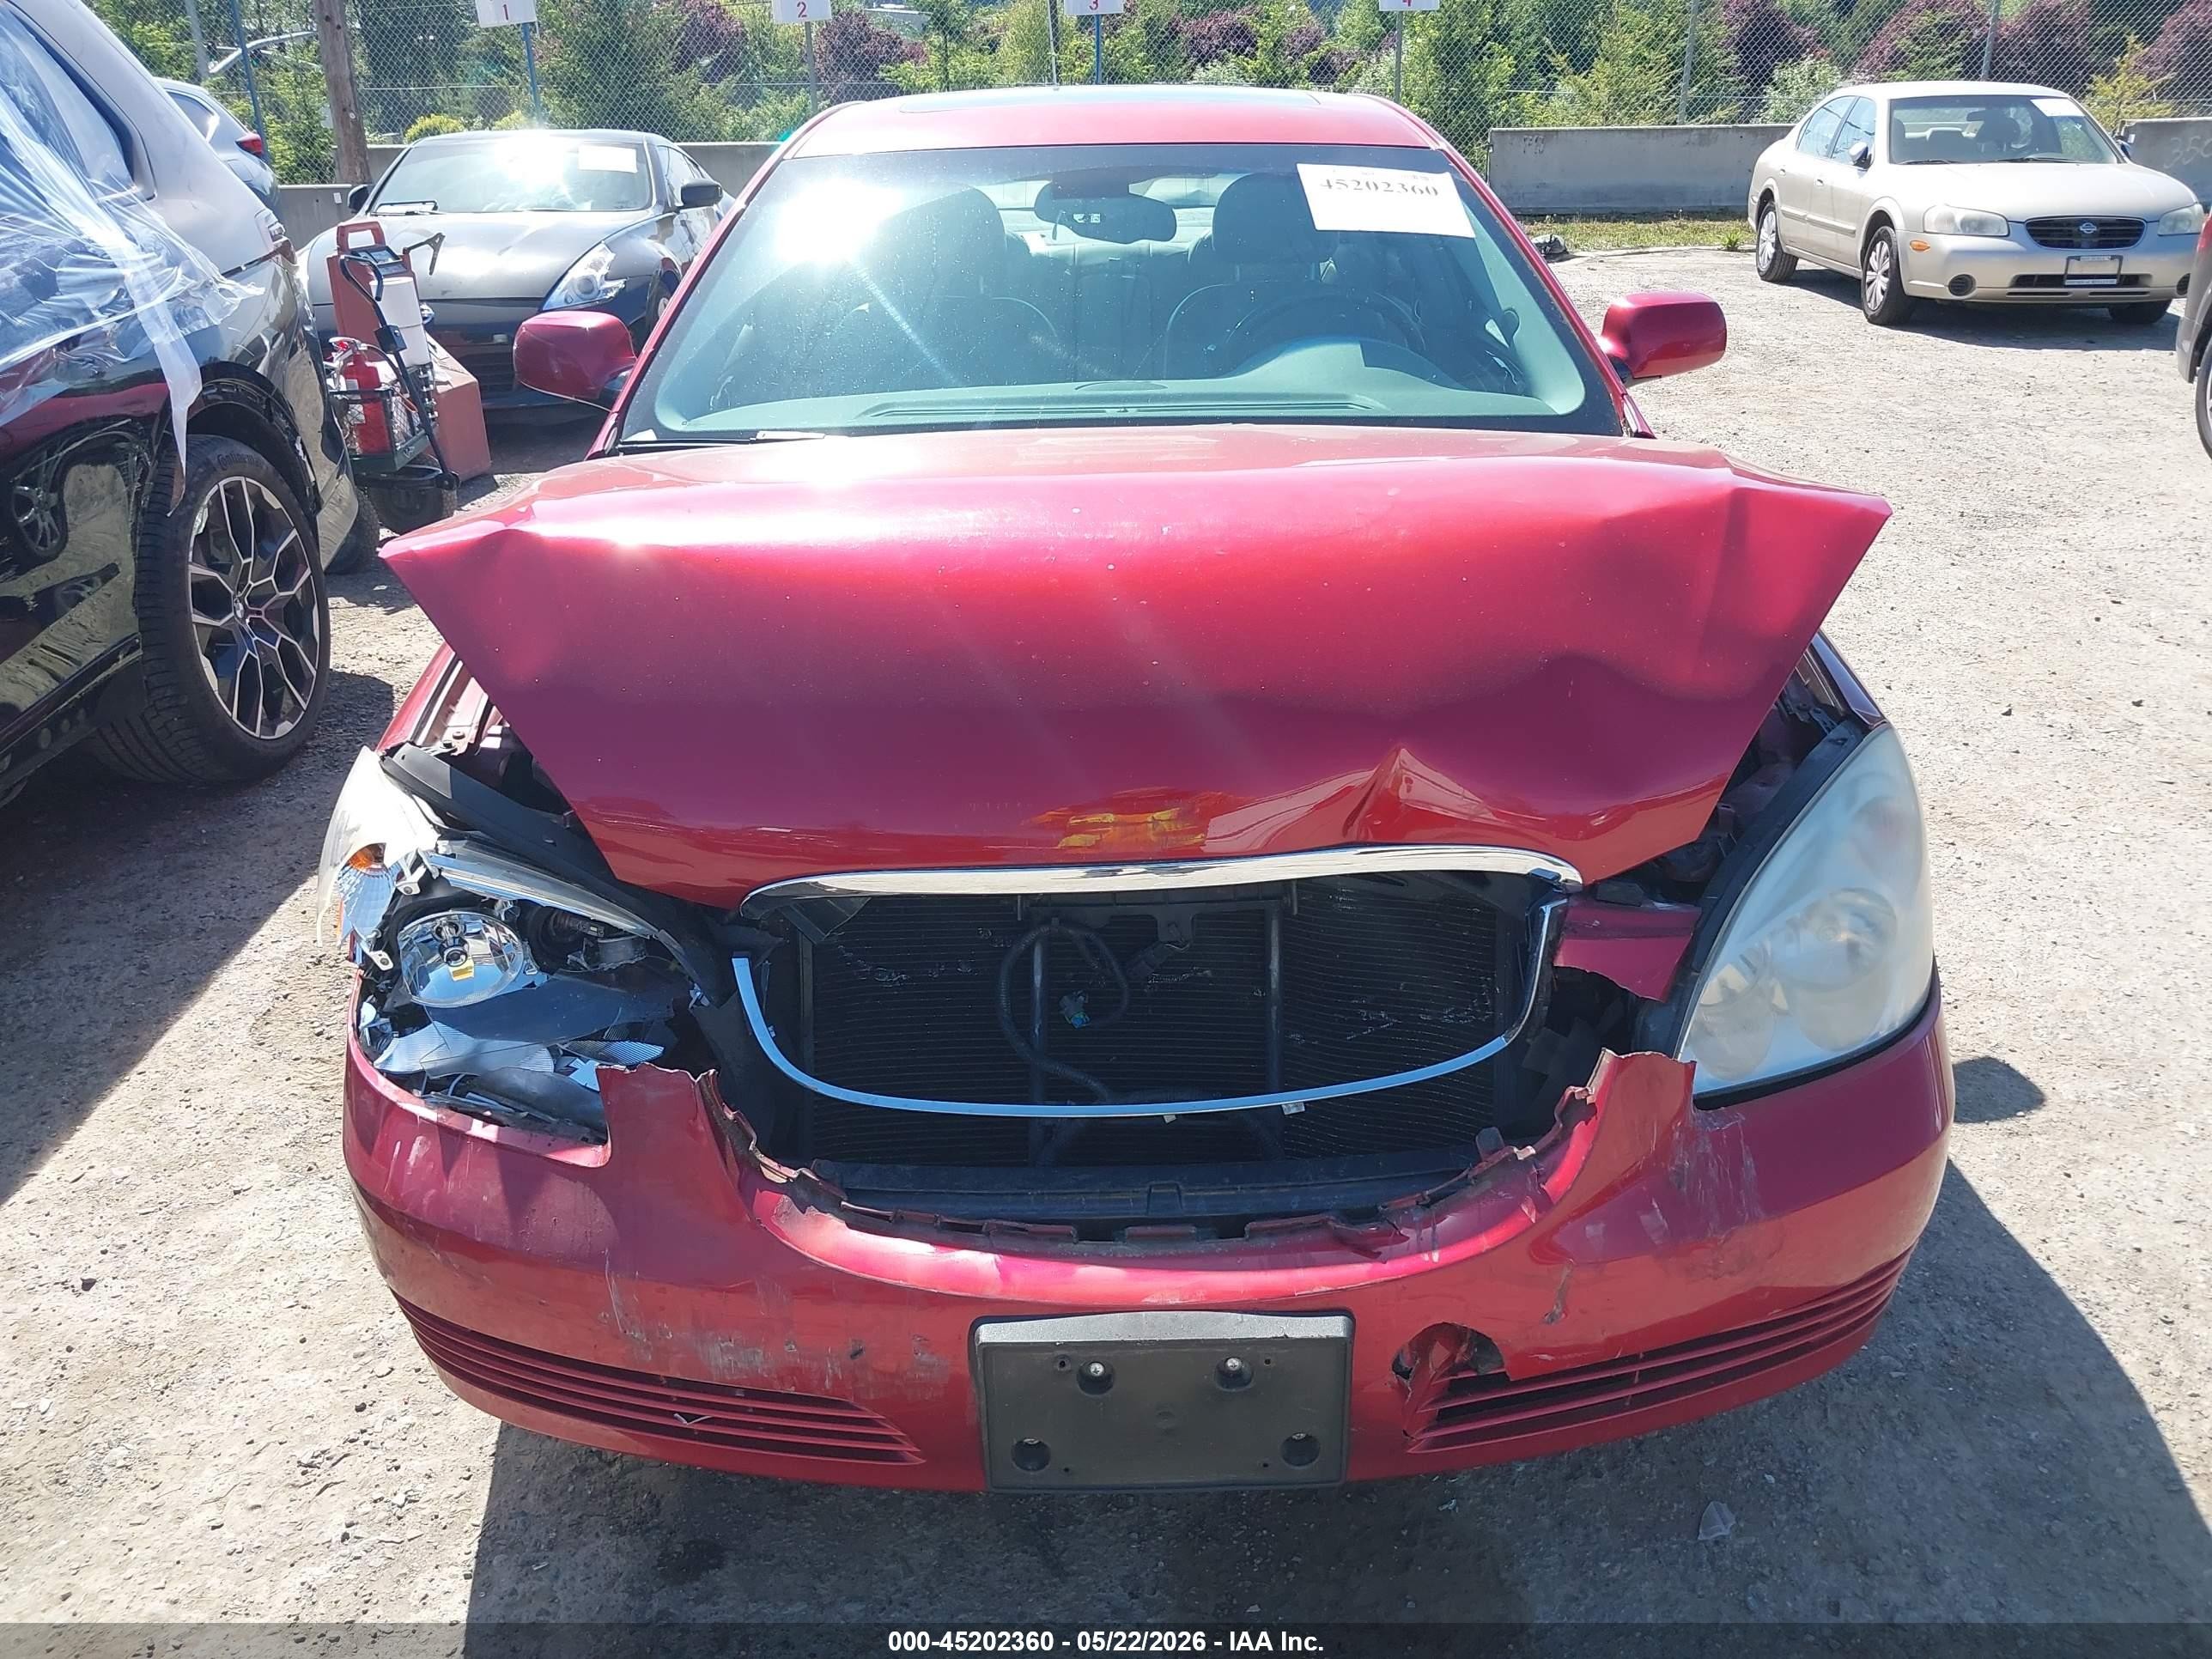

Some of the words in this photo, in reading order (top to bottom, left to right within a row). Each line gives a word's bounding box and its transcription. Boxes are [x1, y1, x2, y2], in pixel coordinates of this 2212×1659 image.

[502, 3, 508, 21] 1
[797, 2, 807, 18] 2
[1319, 178, 1439, 197] 45202360
